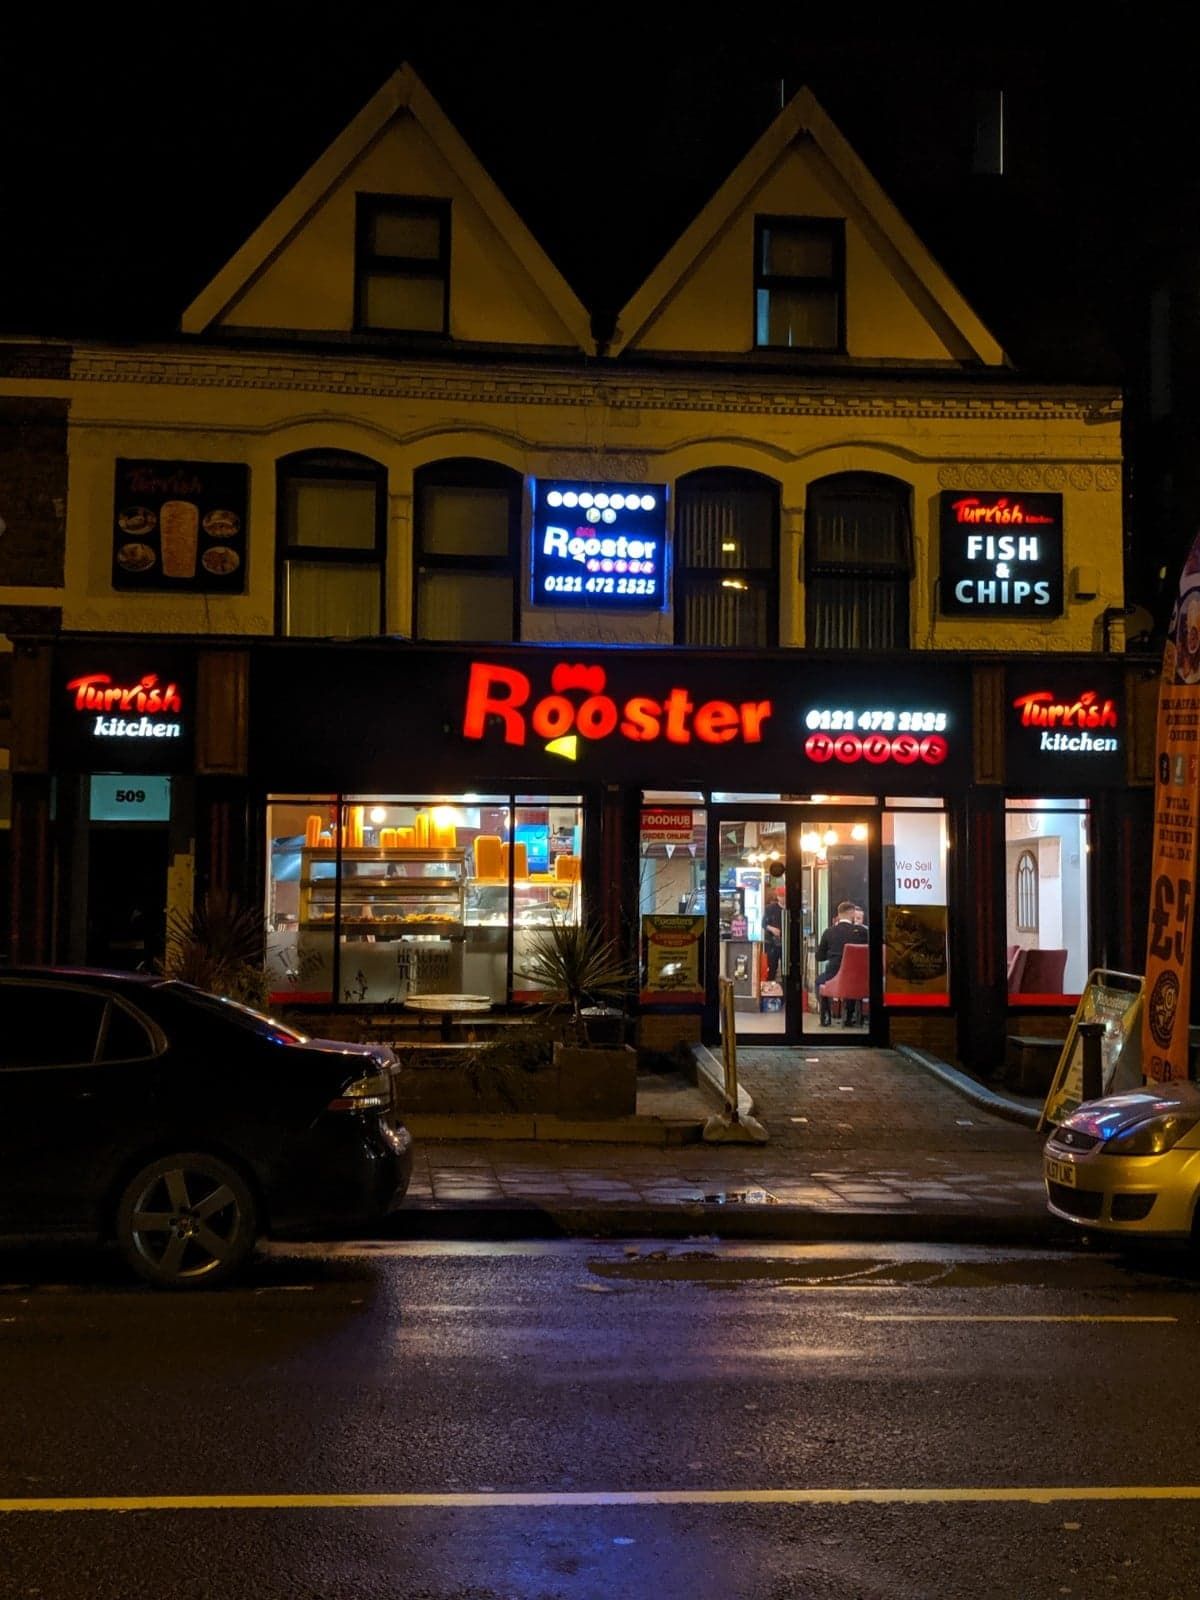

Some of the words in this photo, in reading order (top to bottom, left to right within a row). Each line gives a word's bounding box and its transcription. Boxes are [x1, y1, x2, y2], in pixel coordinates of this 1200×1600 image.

[952, 497, 1024, 524] Turkish
[544, 526, 657, 560] Rooster
[967, 535, 1039, 561] FISH
[995, 562, 1010, 578] &
[544, 576, 582, 592] 0121
[585, 577, 615, 593] 472
[617, 578, 656, 594] 2525
[955, 579, 1050, 605] CHIPS
[67, 673, 181, 713] Turkish
[463, 661, 772, 746] Rooster
[1013, 691, 1118, 728] Turkish
[94, 715, 180, 737] kitchen
[805, 710, 854, 730] 0121
[857, 711, 895, 731] 472
[898, 712, 948, 731] 2525
[807, 735, 946, 763] HOUSE
[1040, 731, 1118, 752] kitchen
[115, 789, 146, 803] 509
[641, 814, 691, 826] FOODHUB
[667, 831, 691, 840] ONLINE
[895, 861, 912, 871] We
[914, 860, 932, 871] Sell
[896, 877, 933, 890] 100%
